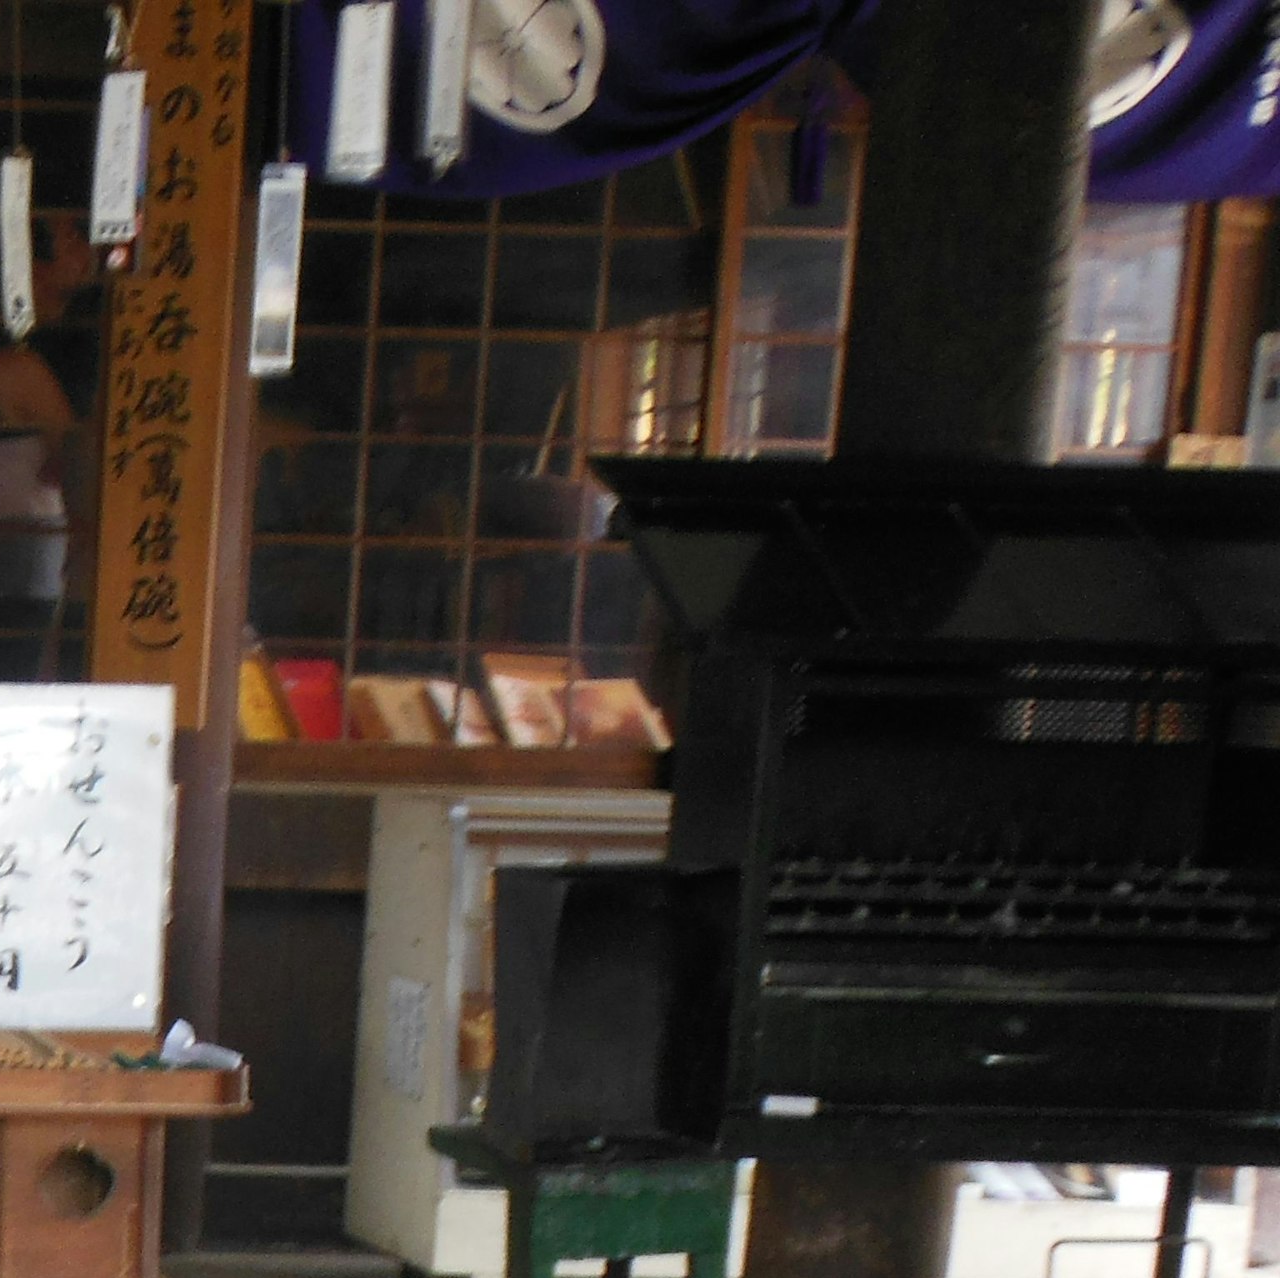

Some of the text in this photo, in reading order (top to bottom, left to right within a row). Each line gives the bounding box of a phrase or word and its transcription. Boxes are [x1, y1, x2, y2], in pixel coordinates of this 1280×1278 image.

[60, 697, 111, 973] おせんこう
